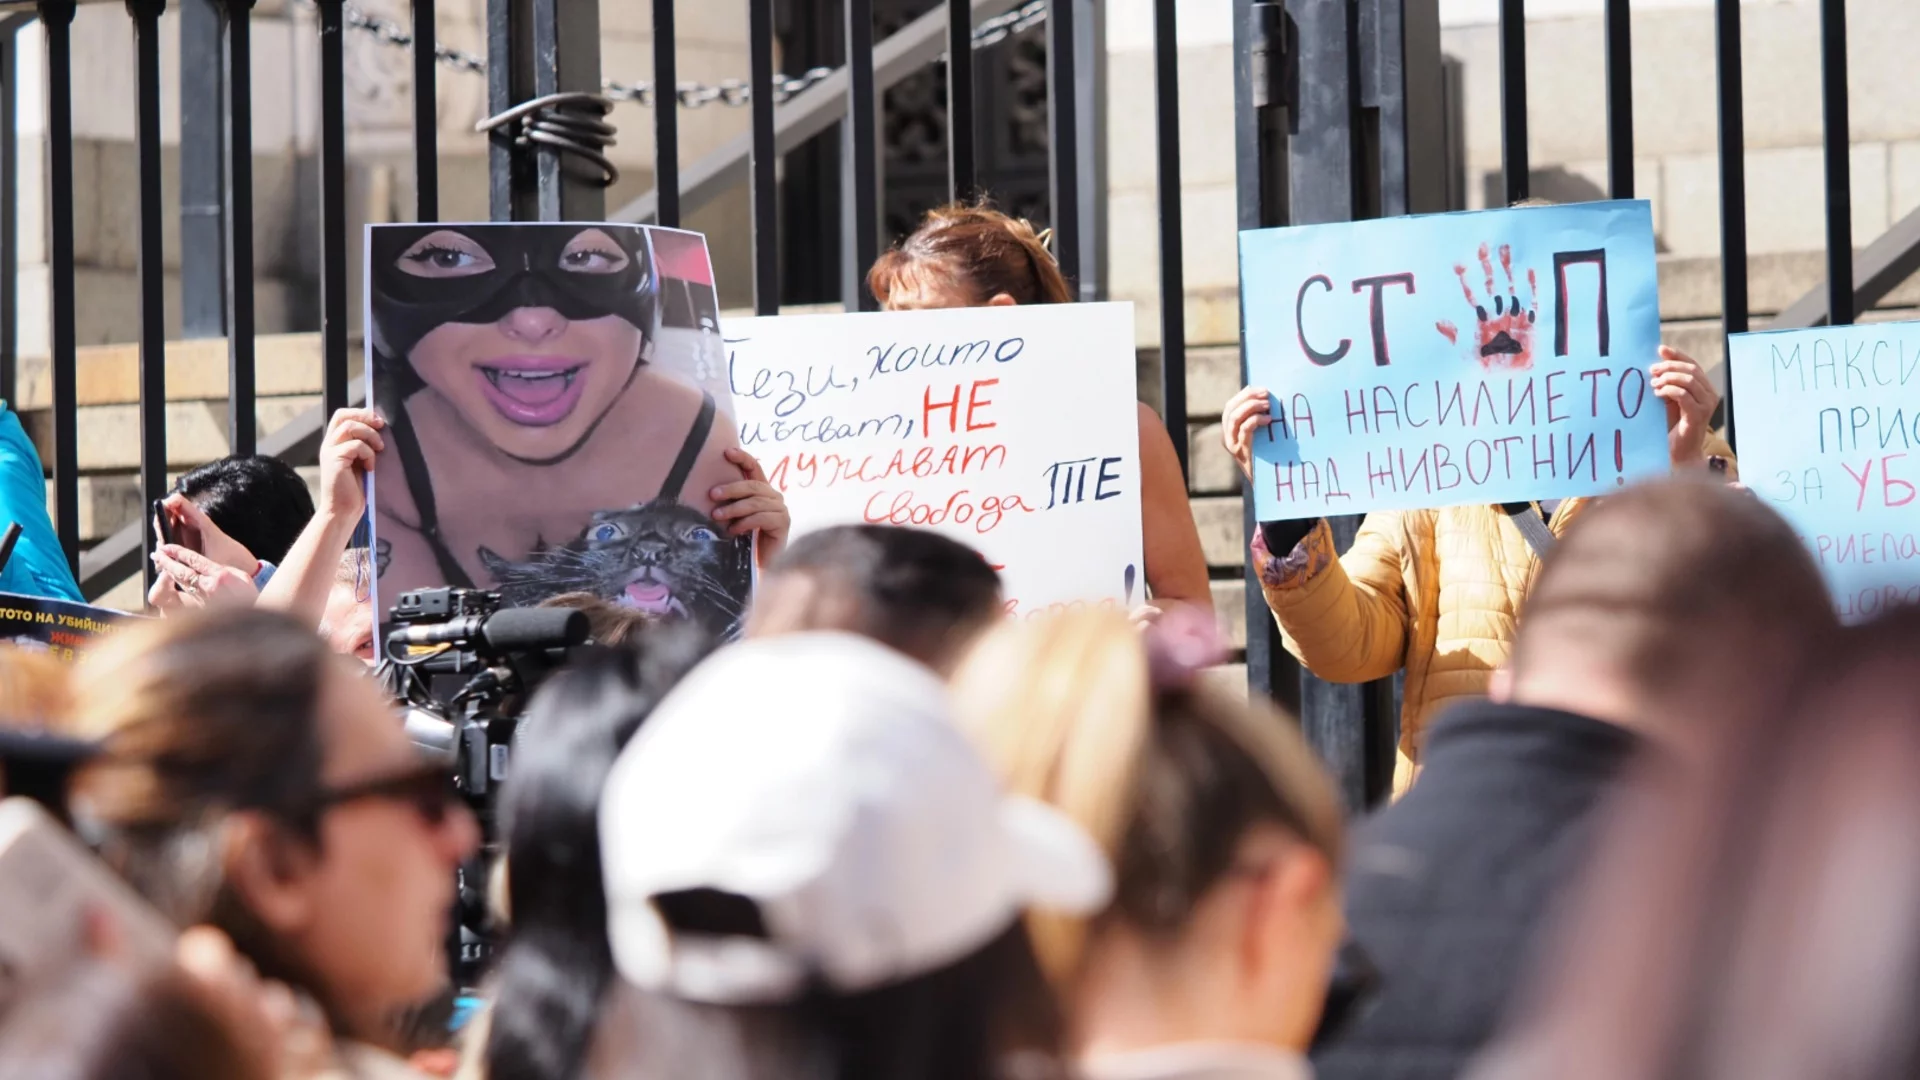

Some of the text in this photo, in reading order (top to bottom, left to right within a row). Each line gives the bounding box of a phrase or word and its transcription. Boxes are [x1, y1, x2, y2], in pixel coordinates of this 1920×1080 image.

[1771, 337, 1920, 394] МАКСИ
[923, 378, 999, 438] НЕ
[1267, 367, 1645, 442] НА НАСИЛИЕТО
[1274, 429, 1625, 506] НАД ЖИВОТНИ!
[1772, 453, 1917, 512] ЗА УБ
[35, 611, 55, 624] НА
[57, 613, 118, 634] УБИЙЦИ
